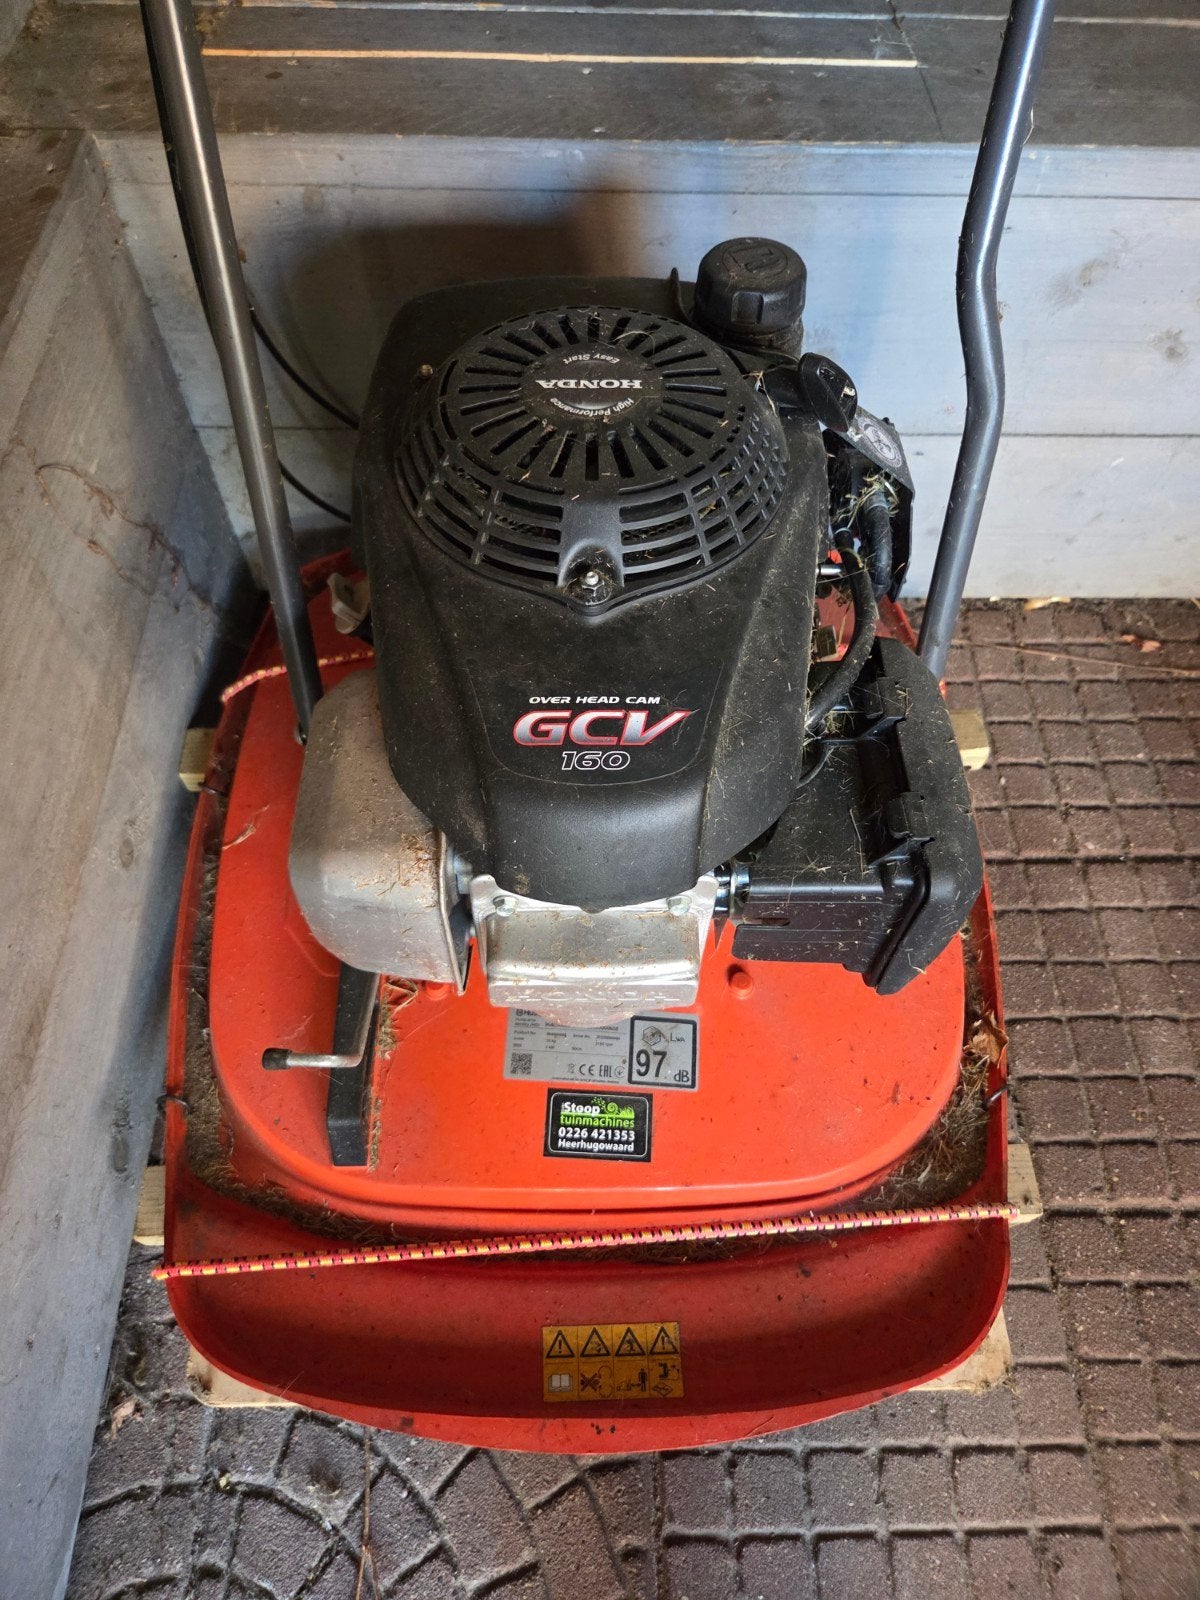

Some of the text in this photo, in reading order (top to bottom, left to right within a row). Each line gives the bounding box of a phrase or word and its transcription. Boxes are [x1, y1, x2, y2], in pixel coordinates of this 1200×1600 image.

[562, 352, 621, 365] Easy Start
[535, 379, 643, 389] HONDA
[550, 397, 635, 417] High Performance
[528, 696, 660, 704] OVER HEAD CAM
[512, 709, 695, 747] GCV
[561, 750, 631, 771] 160
[579, 1064, 596, 1076] CE
[636, 1049, 667, 1078] 97
[674, 1069, 690, 1083] dB
[564, 1101, 601, 1117] Stoop
[560, 1114, 635, 1129] tuinmachines
[558, 1126, 636, 1142] 0226 421353
[557, 1138, 635, 1153] Heerhugowaard
